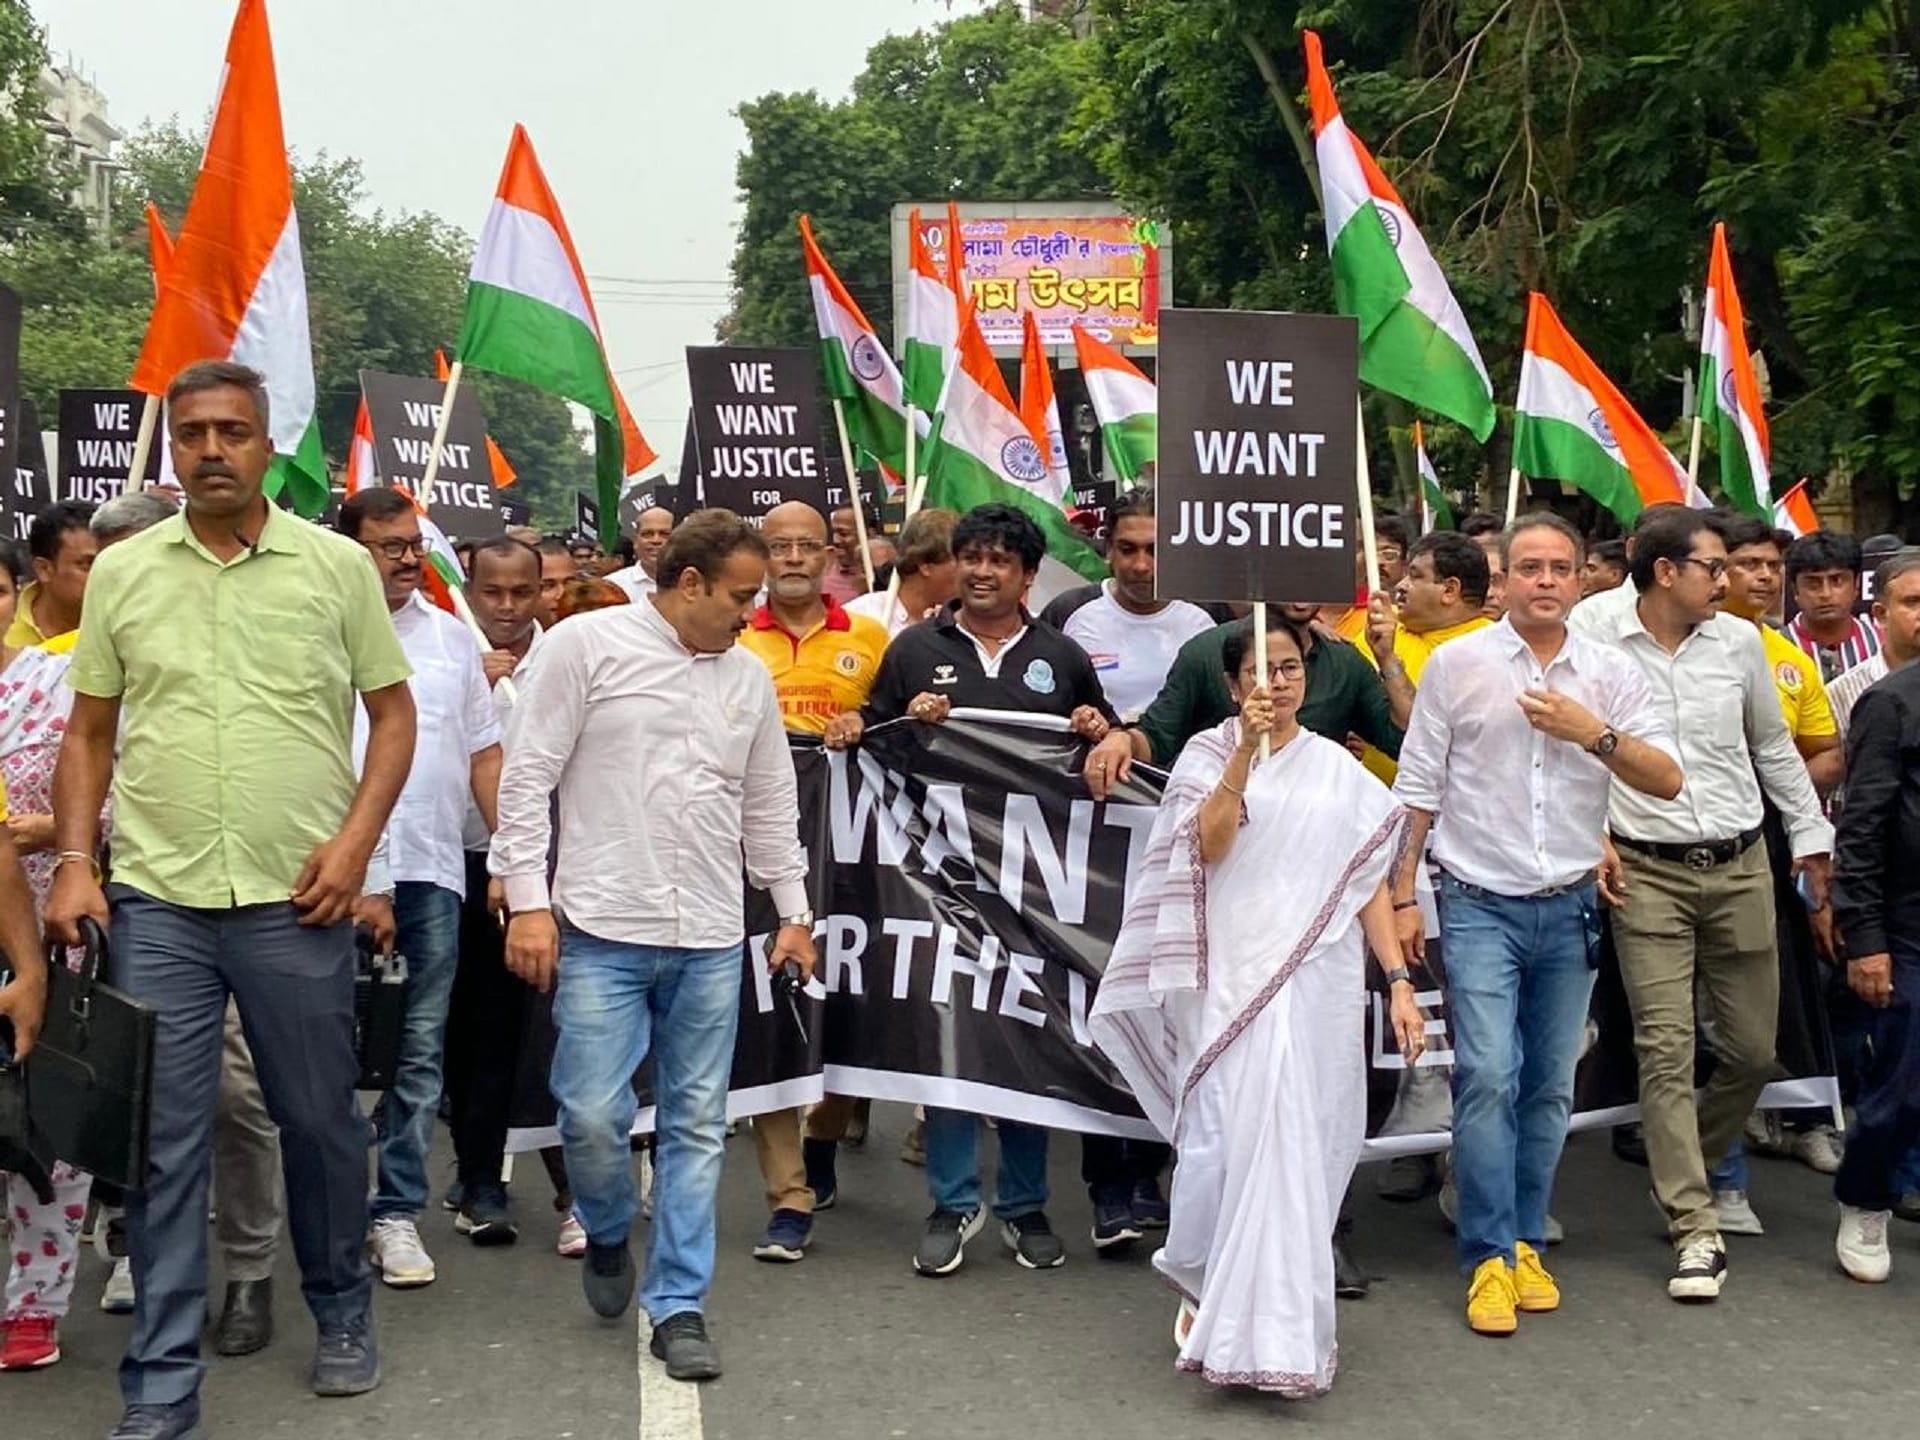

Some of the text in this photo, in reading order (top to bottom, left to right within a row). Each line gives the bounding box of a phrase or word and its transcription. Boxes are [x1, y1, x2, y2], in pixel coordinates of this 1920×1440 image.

[1029, 266, 1143, 313] উৎসব
[730, 363, 775, 393] WE
[1226, 360, 1294, 405] WE
[94, 403, 130, 430] WE
[716, 405, 798, 435] WANT
[393, 437, 471, 469] WANT
[710, 446, 817, 478] JUSTICE
[1194, 431, 1325, 477] WANT
[632, 493, 656, 512] WE
[752, 490, 781, 504] FOR
[1074, 489, 1096, 505] WE
[1170, 500, 1345, 548] JUSTICE
[882, 918, 1048, 1028] THE
